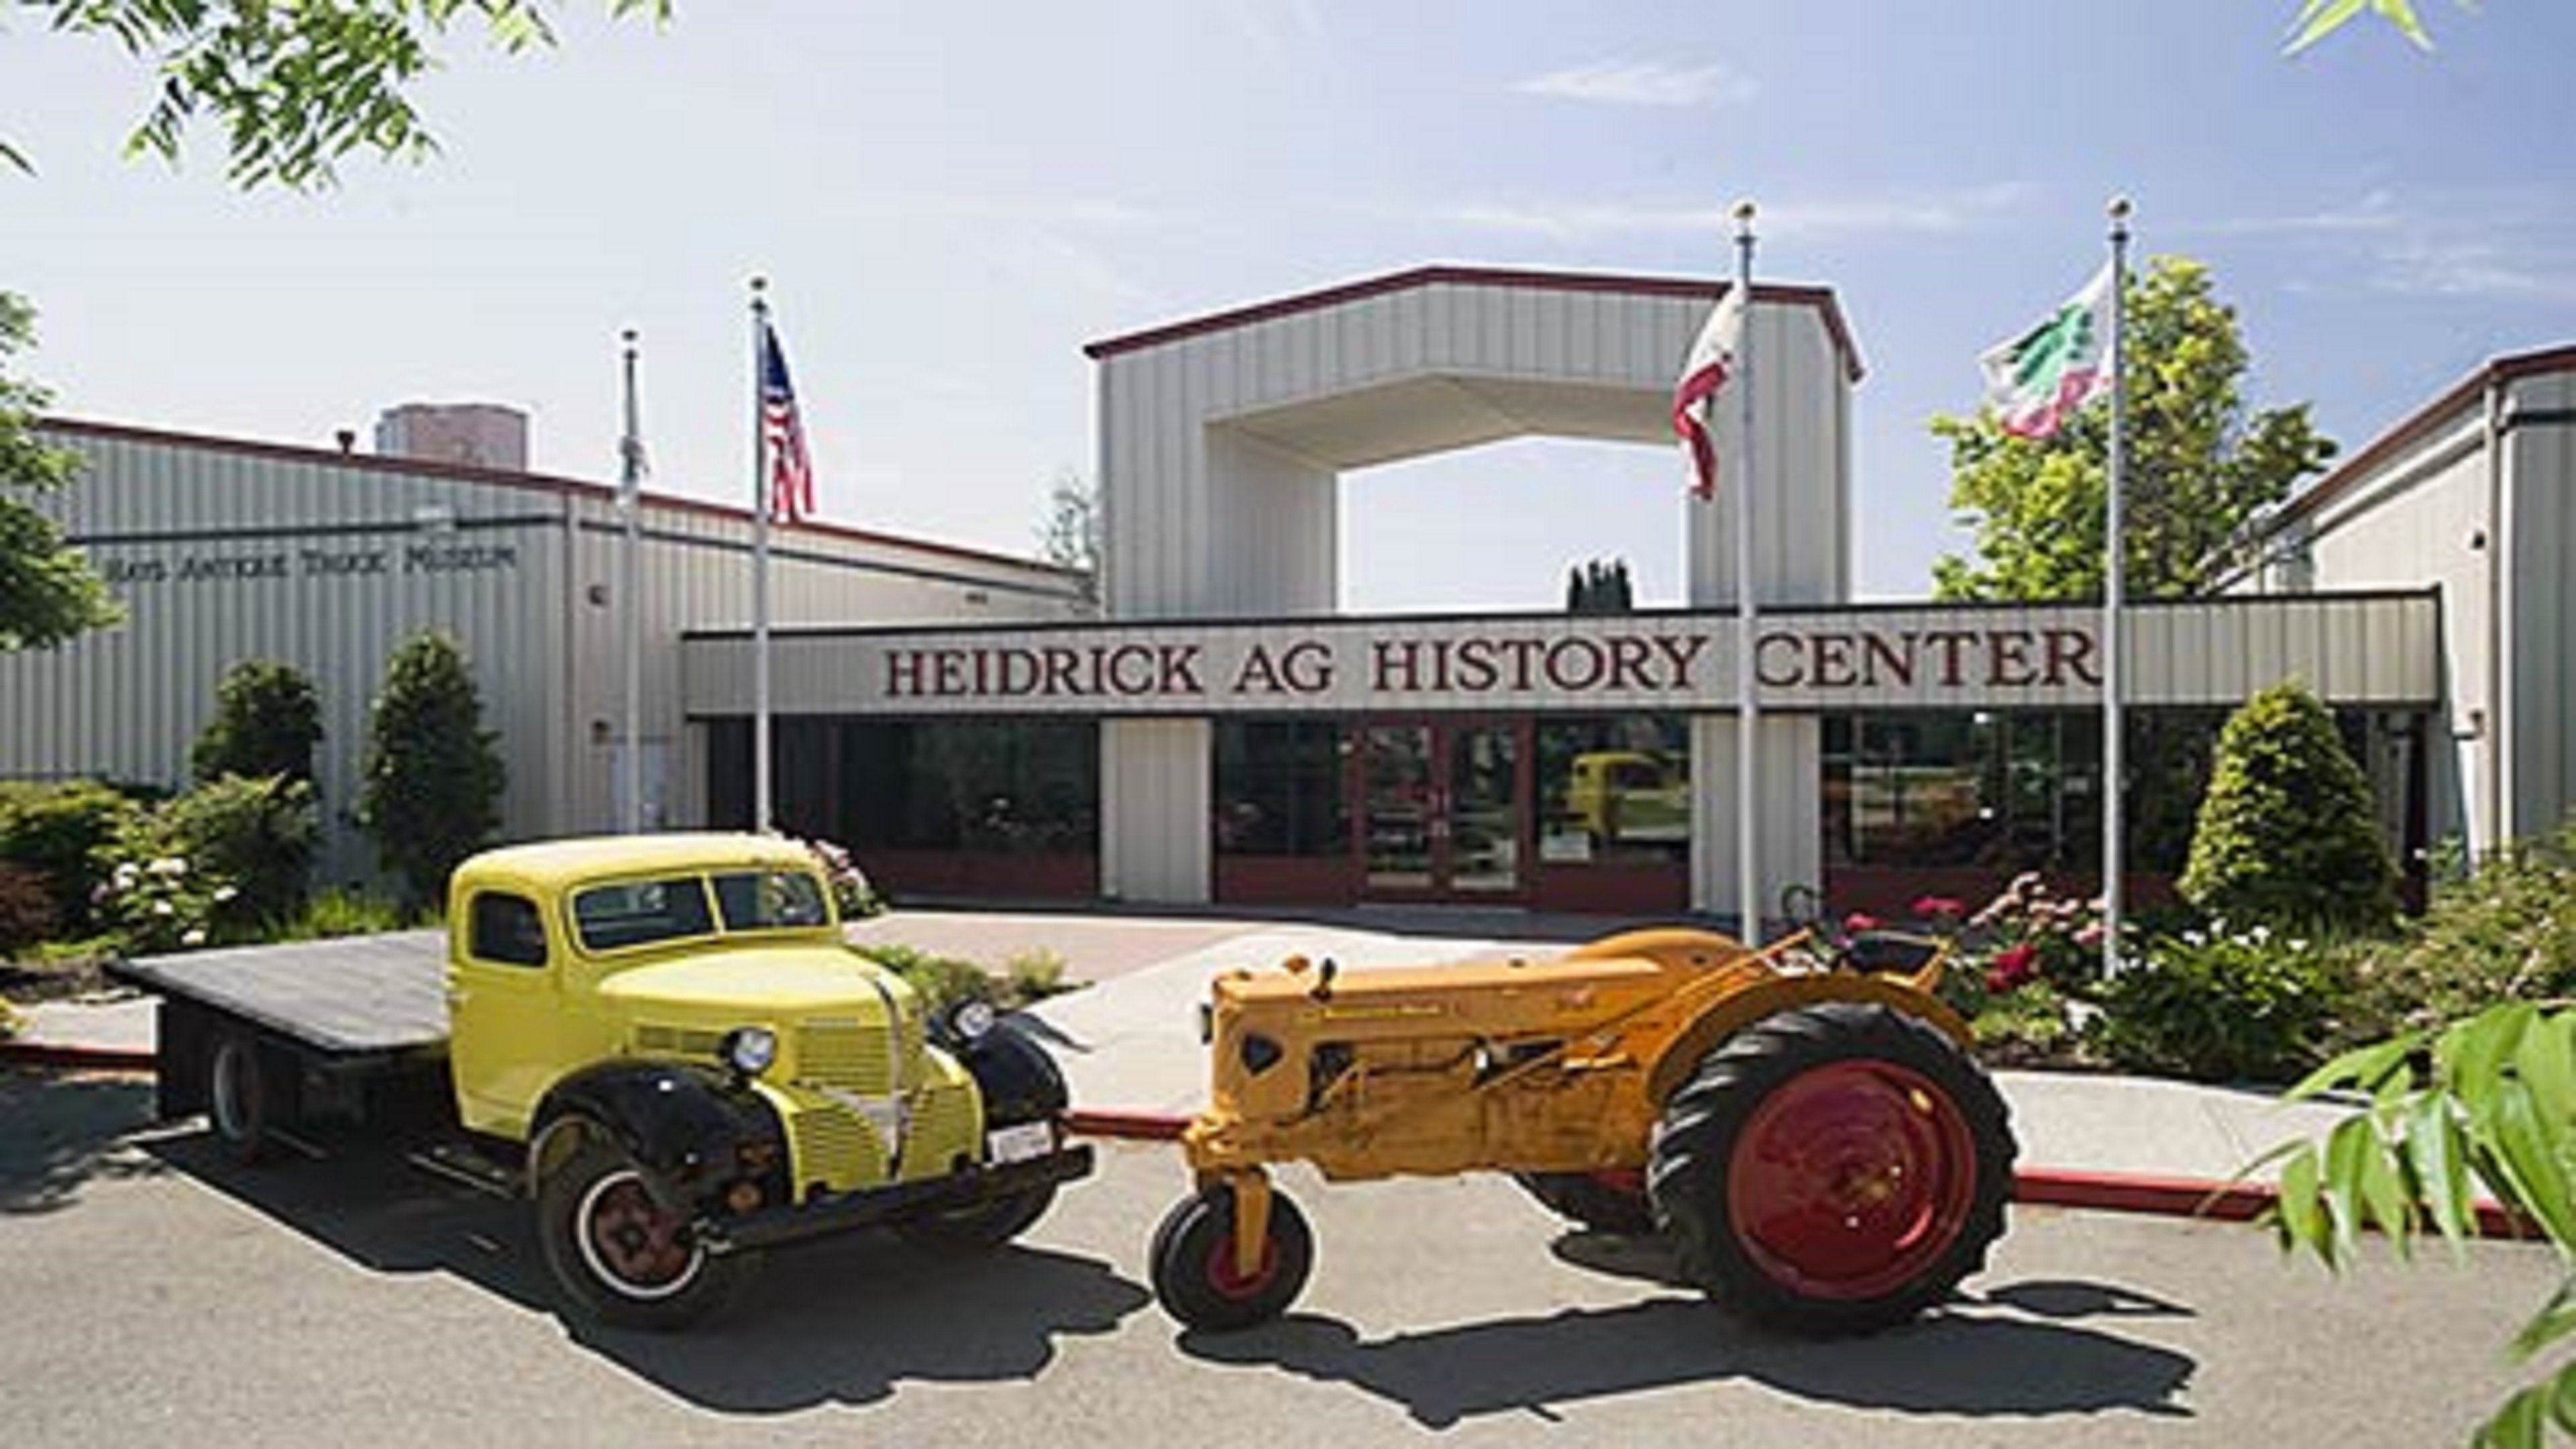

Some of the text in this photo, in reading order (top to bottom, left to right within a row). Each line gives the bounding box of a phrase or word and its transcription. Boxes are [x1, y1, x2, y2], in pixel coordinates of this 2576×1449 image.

[884, 629, 2104, 698] HEIDRICK AG HISTORY CENTER
